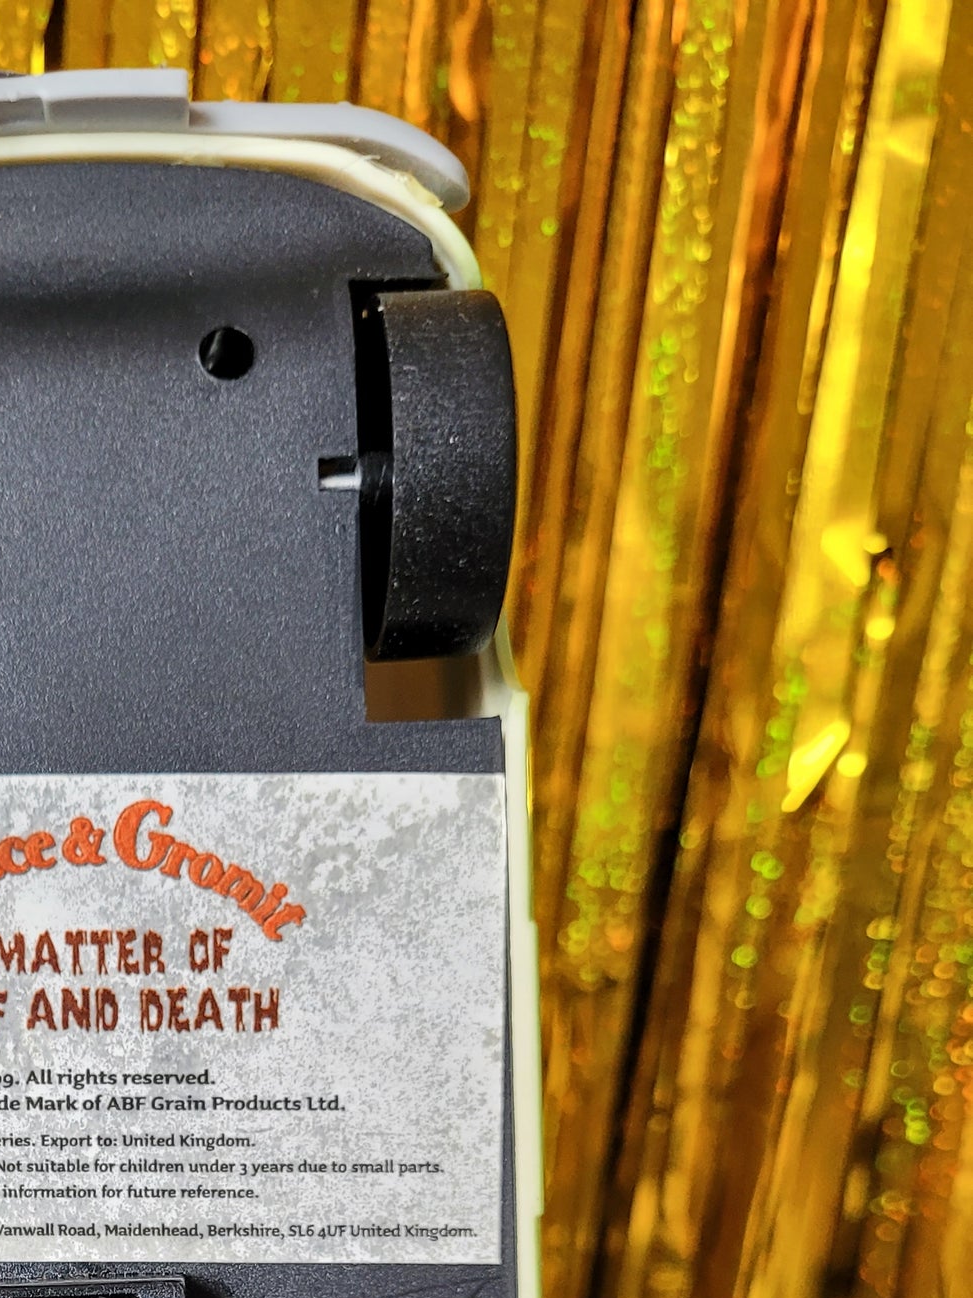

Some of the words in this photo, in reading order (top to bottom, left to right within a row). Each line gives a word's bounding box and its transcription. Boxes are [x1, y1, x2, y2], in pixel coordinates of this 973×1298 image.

[62, 816, 107, 866] &
[113, 799, 307, 942] Gromit
[188, 928, 233, 973] OF
[26, 987, 119, 1033] AND
[139, 986, 280, 1033] DEATH
[26, 1069, 53, 1086] All
[57, 1069, 117, 1089] rights
[122, 1069, 215, 1086] reserved.
[26, 1096, 78, 1111] Mark
[83, 1095, 103, 1111] of
[107, 1096, 146, 1111] ABF
[151, 1096, 206, 1111] Grain
[212, 1096, 301, 1111] Products
[306, 1096, 345, 1111] Ltd.
[41, 1134, 93, 1152] Export
[96, 1135, 117, 1148] to:
[122, 1134, 174, 1148] United
[179, 1134, 256, 1152] Kingdom.
[26, 1160, 89, 1173] suitable
[94, 1160, 115, 1173] for
[120, 1160, 184, 1173] children
[189, 1160, 236, 1173] under
[239, 1163, 248, 1176] 3
[251, 1163, 293, 1177] years
[298, 1160, 327, 1173] due
[331, 1162, 347, 1173] to
[351, 1160, 395, 1173] small
[399, 1162, 444, 1176] parts.
[2, 1185, 96, 1199] information
[101, 1185, 123, 1199] for
[127, 1185, 177, 1199] future
[180, 1185, 260, 1199] reference.
[58, 1224, 101, 1238] Road,
[104, 1224, 203, 1239] Maidenhead,
[207, 1224, 285, 1239] Berkshire,
[288, 1225, 314, 1237] SL6
[317, 1225, 347, 1240] 4UF
[350, 1224, 401, 1238] United
[404, 1224, 478, 1241] Kingdom.
